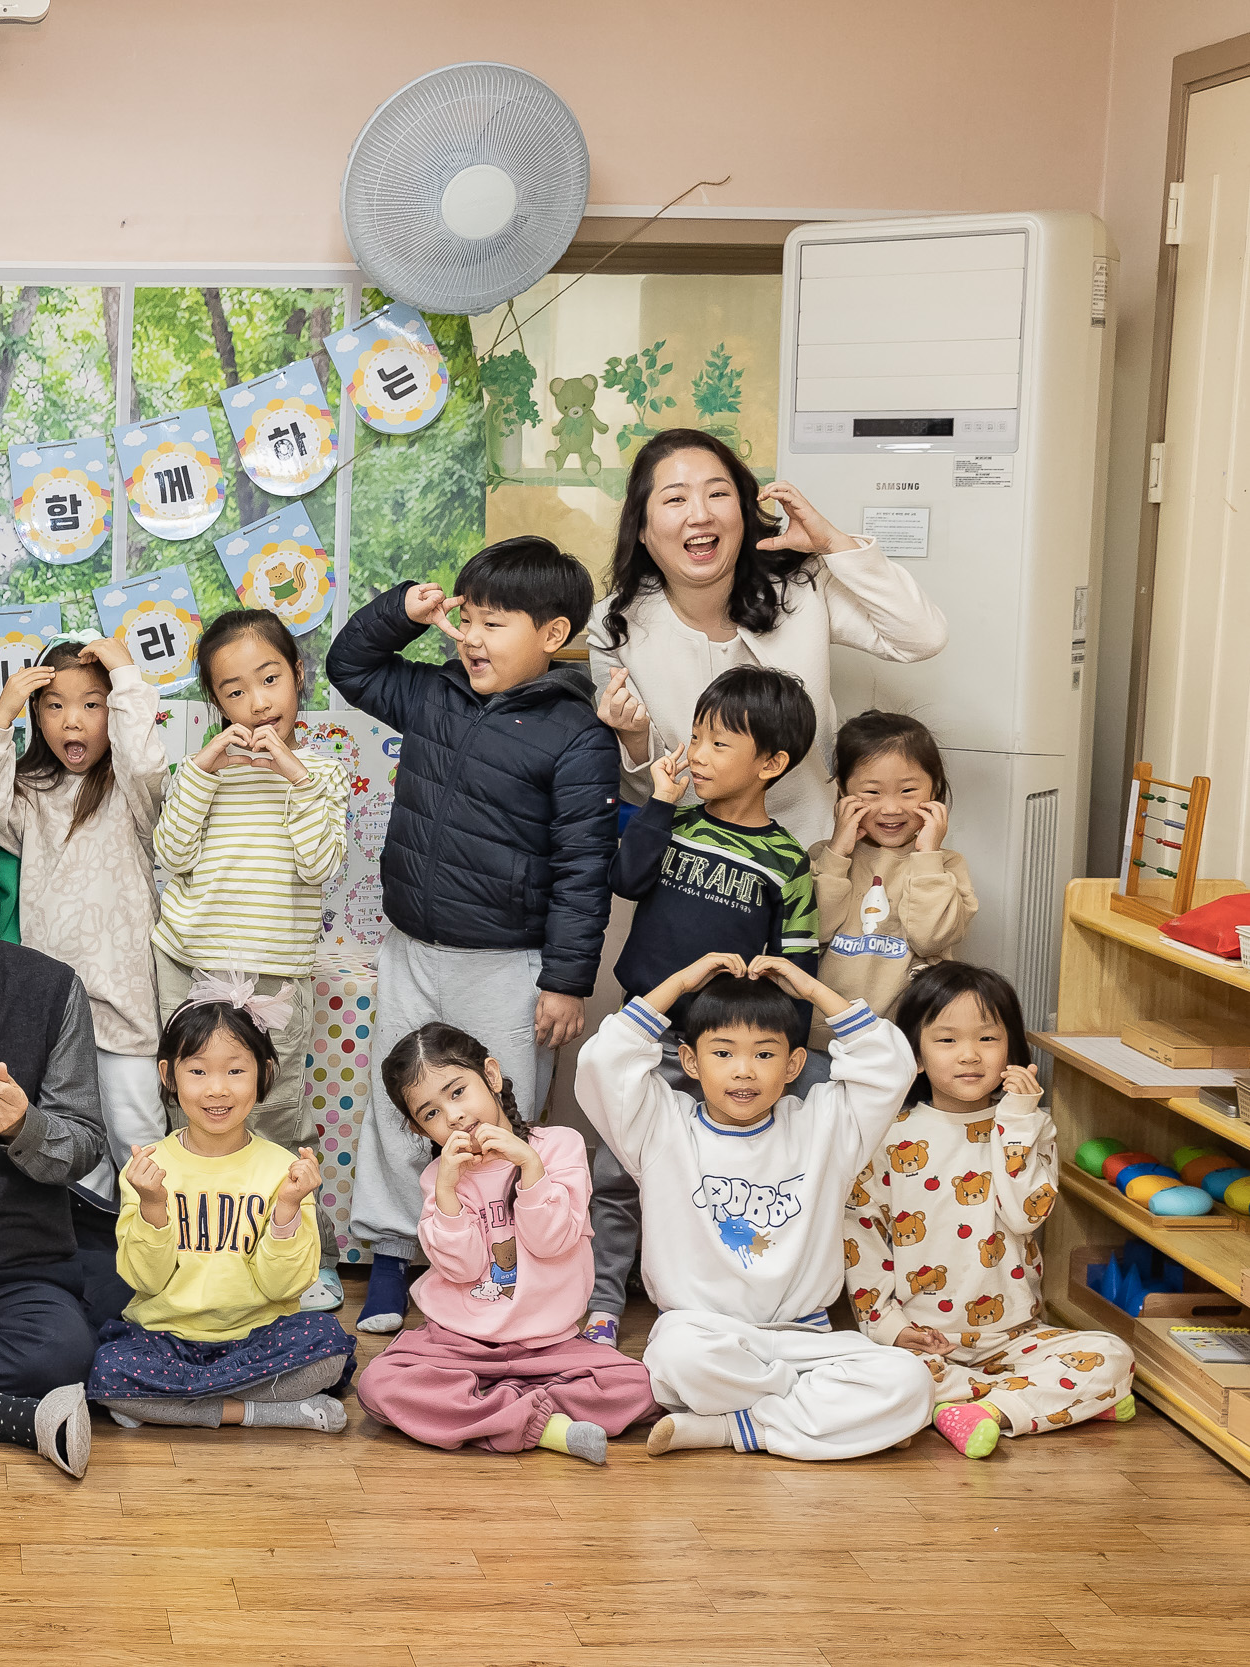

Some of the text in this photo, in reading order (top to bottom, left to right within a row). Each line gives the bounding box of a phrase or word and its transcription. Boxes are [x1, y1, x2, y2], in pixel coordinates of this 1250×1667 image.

[876, 482, 920, 491] SAMSUNG
[136, 625, 177, 662] 라
[661, 845, 768, 907] LTRAHIT
[173, 1190, 267, 1256] RADIS
